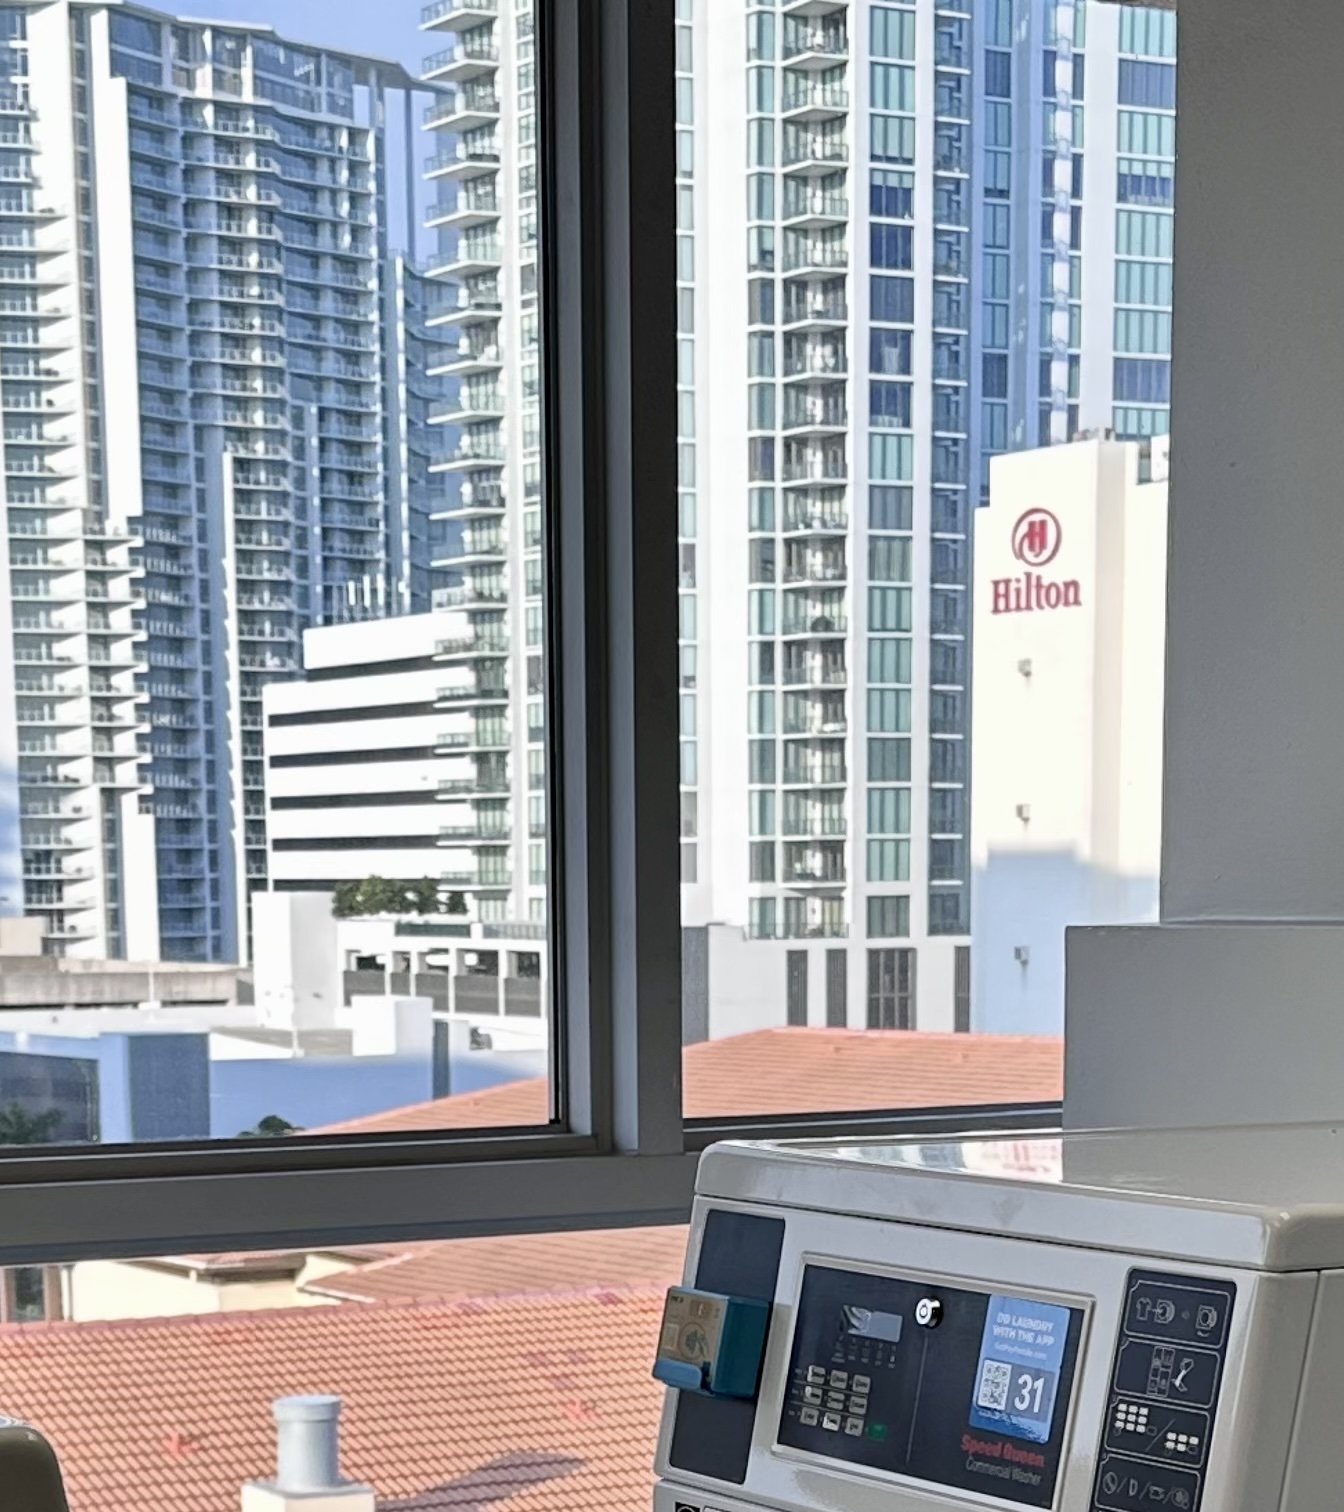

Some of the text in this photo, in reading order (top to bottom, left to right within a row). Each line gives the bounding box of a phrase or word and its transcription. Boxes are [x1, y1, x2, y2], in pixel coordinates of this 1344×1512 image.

[991, 571, 1082, 615] Hilton
[1012, 1315, 1054, 1333] LAUNDRY
[1036, 1334, 1055, 1346] APP
[1014, 1374, 1045, 1413] 31
